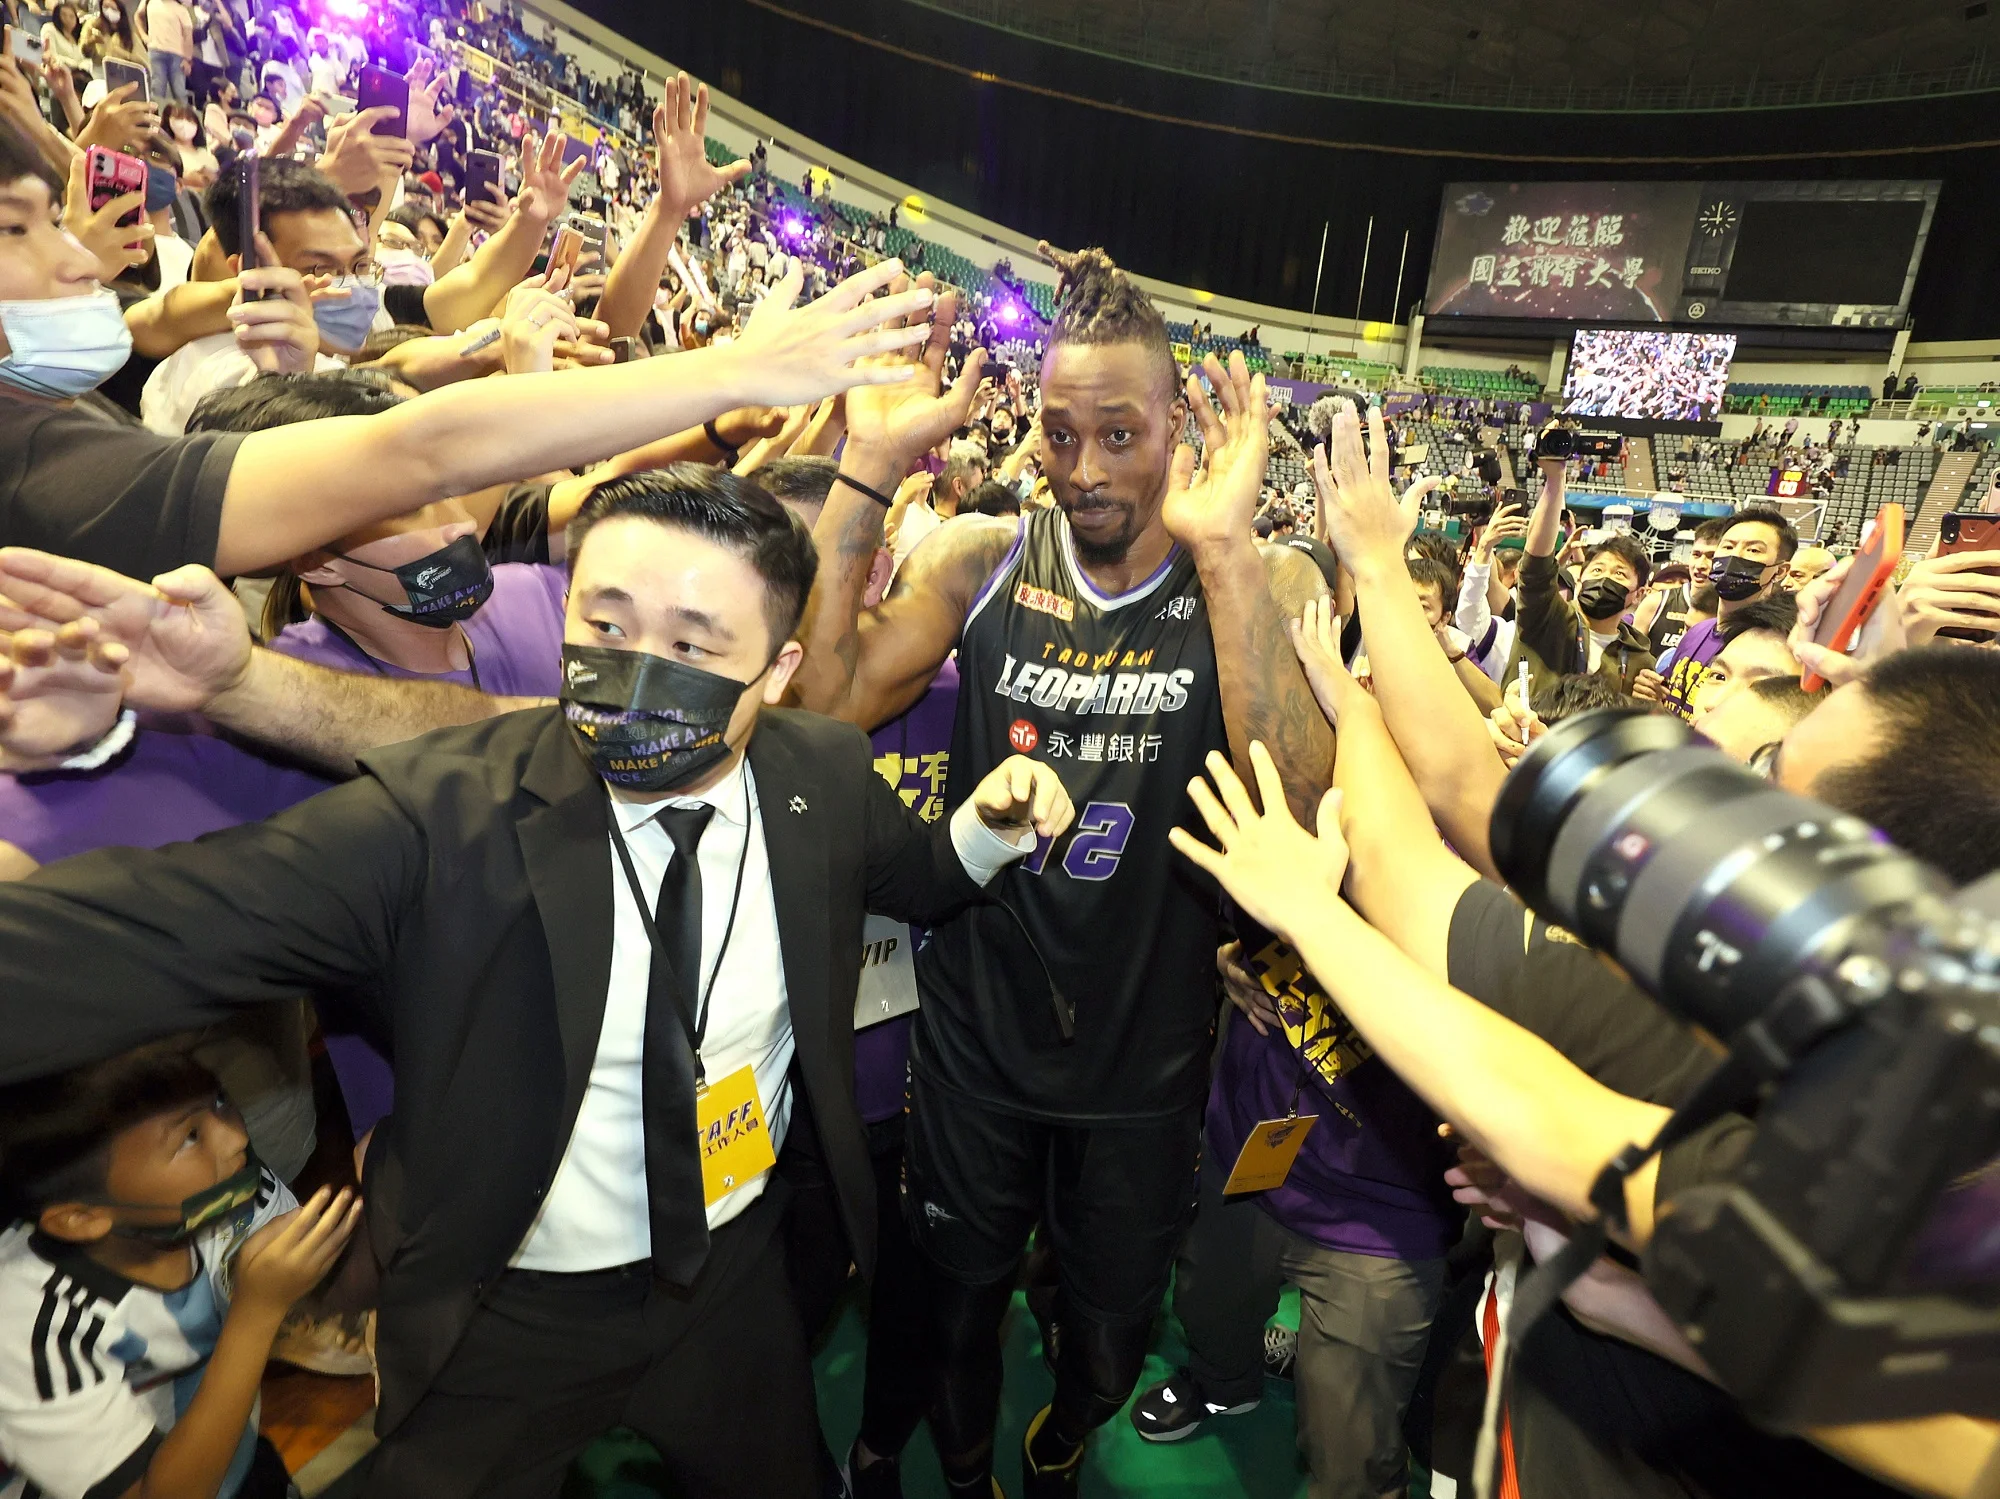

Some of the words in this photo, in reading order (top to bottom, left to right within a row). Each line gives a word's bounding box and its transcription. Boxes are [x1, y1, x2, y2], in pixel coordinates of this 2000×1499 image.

[1469, 254, 1645, 289] 國立體育大學
[1690, 266, 1721, 275] SEIKO
[1626, 500, 1647, 508] TAIPEI
[1042, 642, 1154, 670] TAOYUAN
[995, 653, 1194, 715] LEOPARDS
[631, 732, 680, 756] MAKE
[684, 727, 696, 744] A
[1047, 729, 1163, 764] 永豐銀行
[609, 757, 658, 771] MAKE
